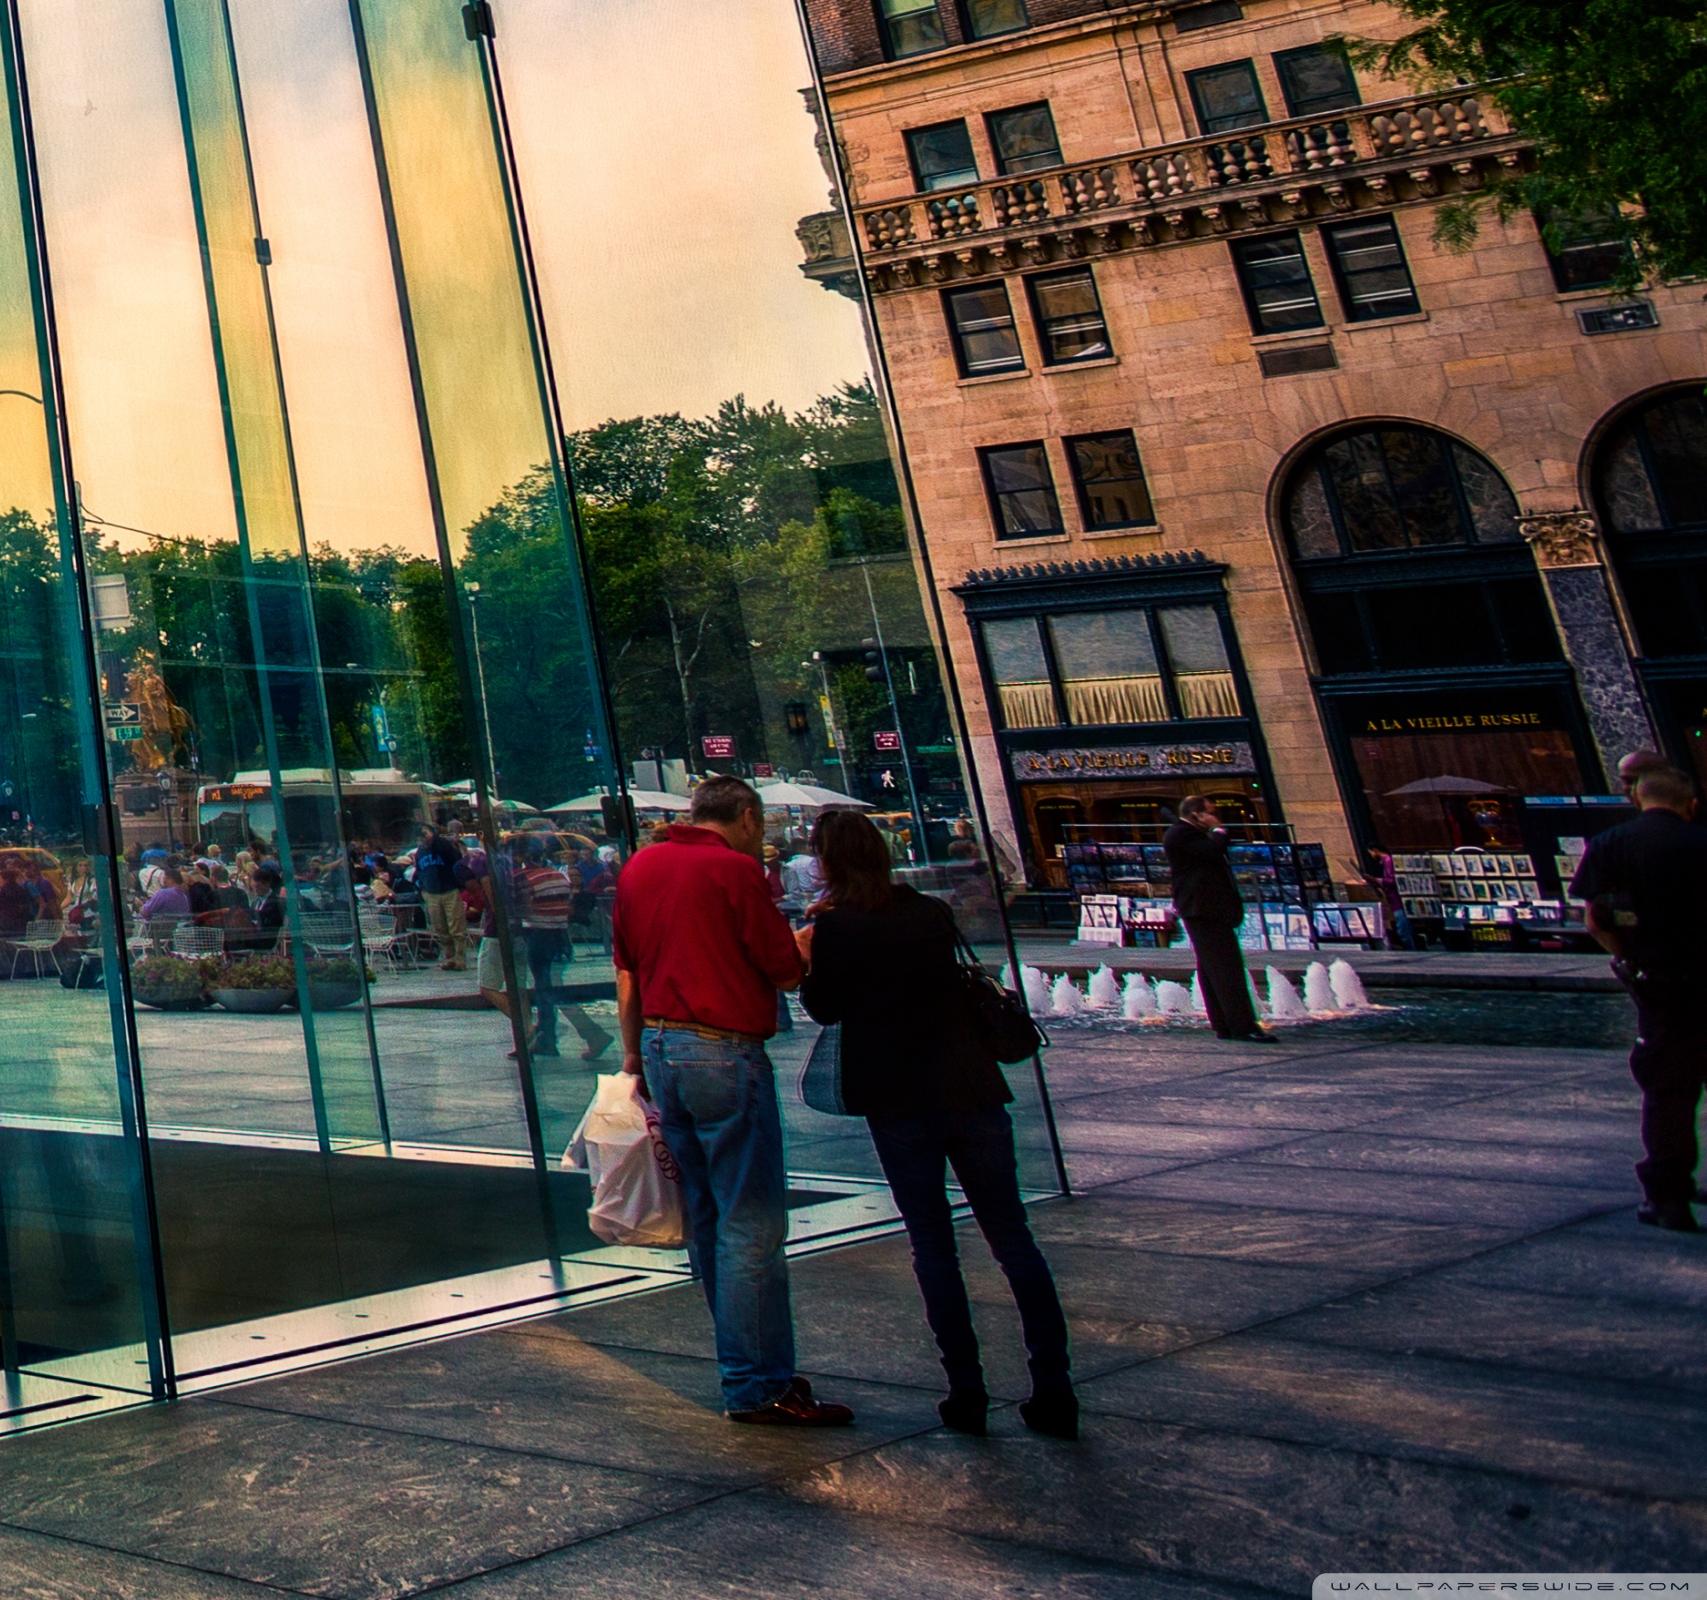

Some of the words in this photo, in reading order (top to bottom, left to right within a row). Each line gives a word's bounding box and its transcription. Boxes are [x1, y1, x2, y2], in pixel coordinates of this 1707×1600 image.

[1366, 720, 1378, 731] A
[1381, 719, 1403, 730] LA
[1407, 716, 1476, 729] VIEILLE
[1480, 713, 1541, 727] RUSSIE
[1027, 756, 1041, 771] A
[1045, 755, 1073, 770] LA
[1073, 752, 1150, 769] VIEILLE
[1166, 749, 1235, 765] RUSSIE
